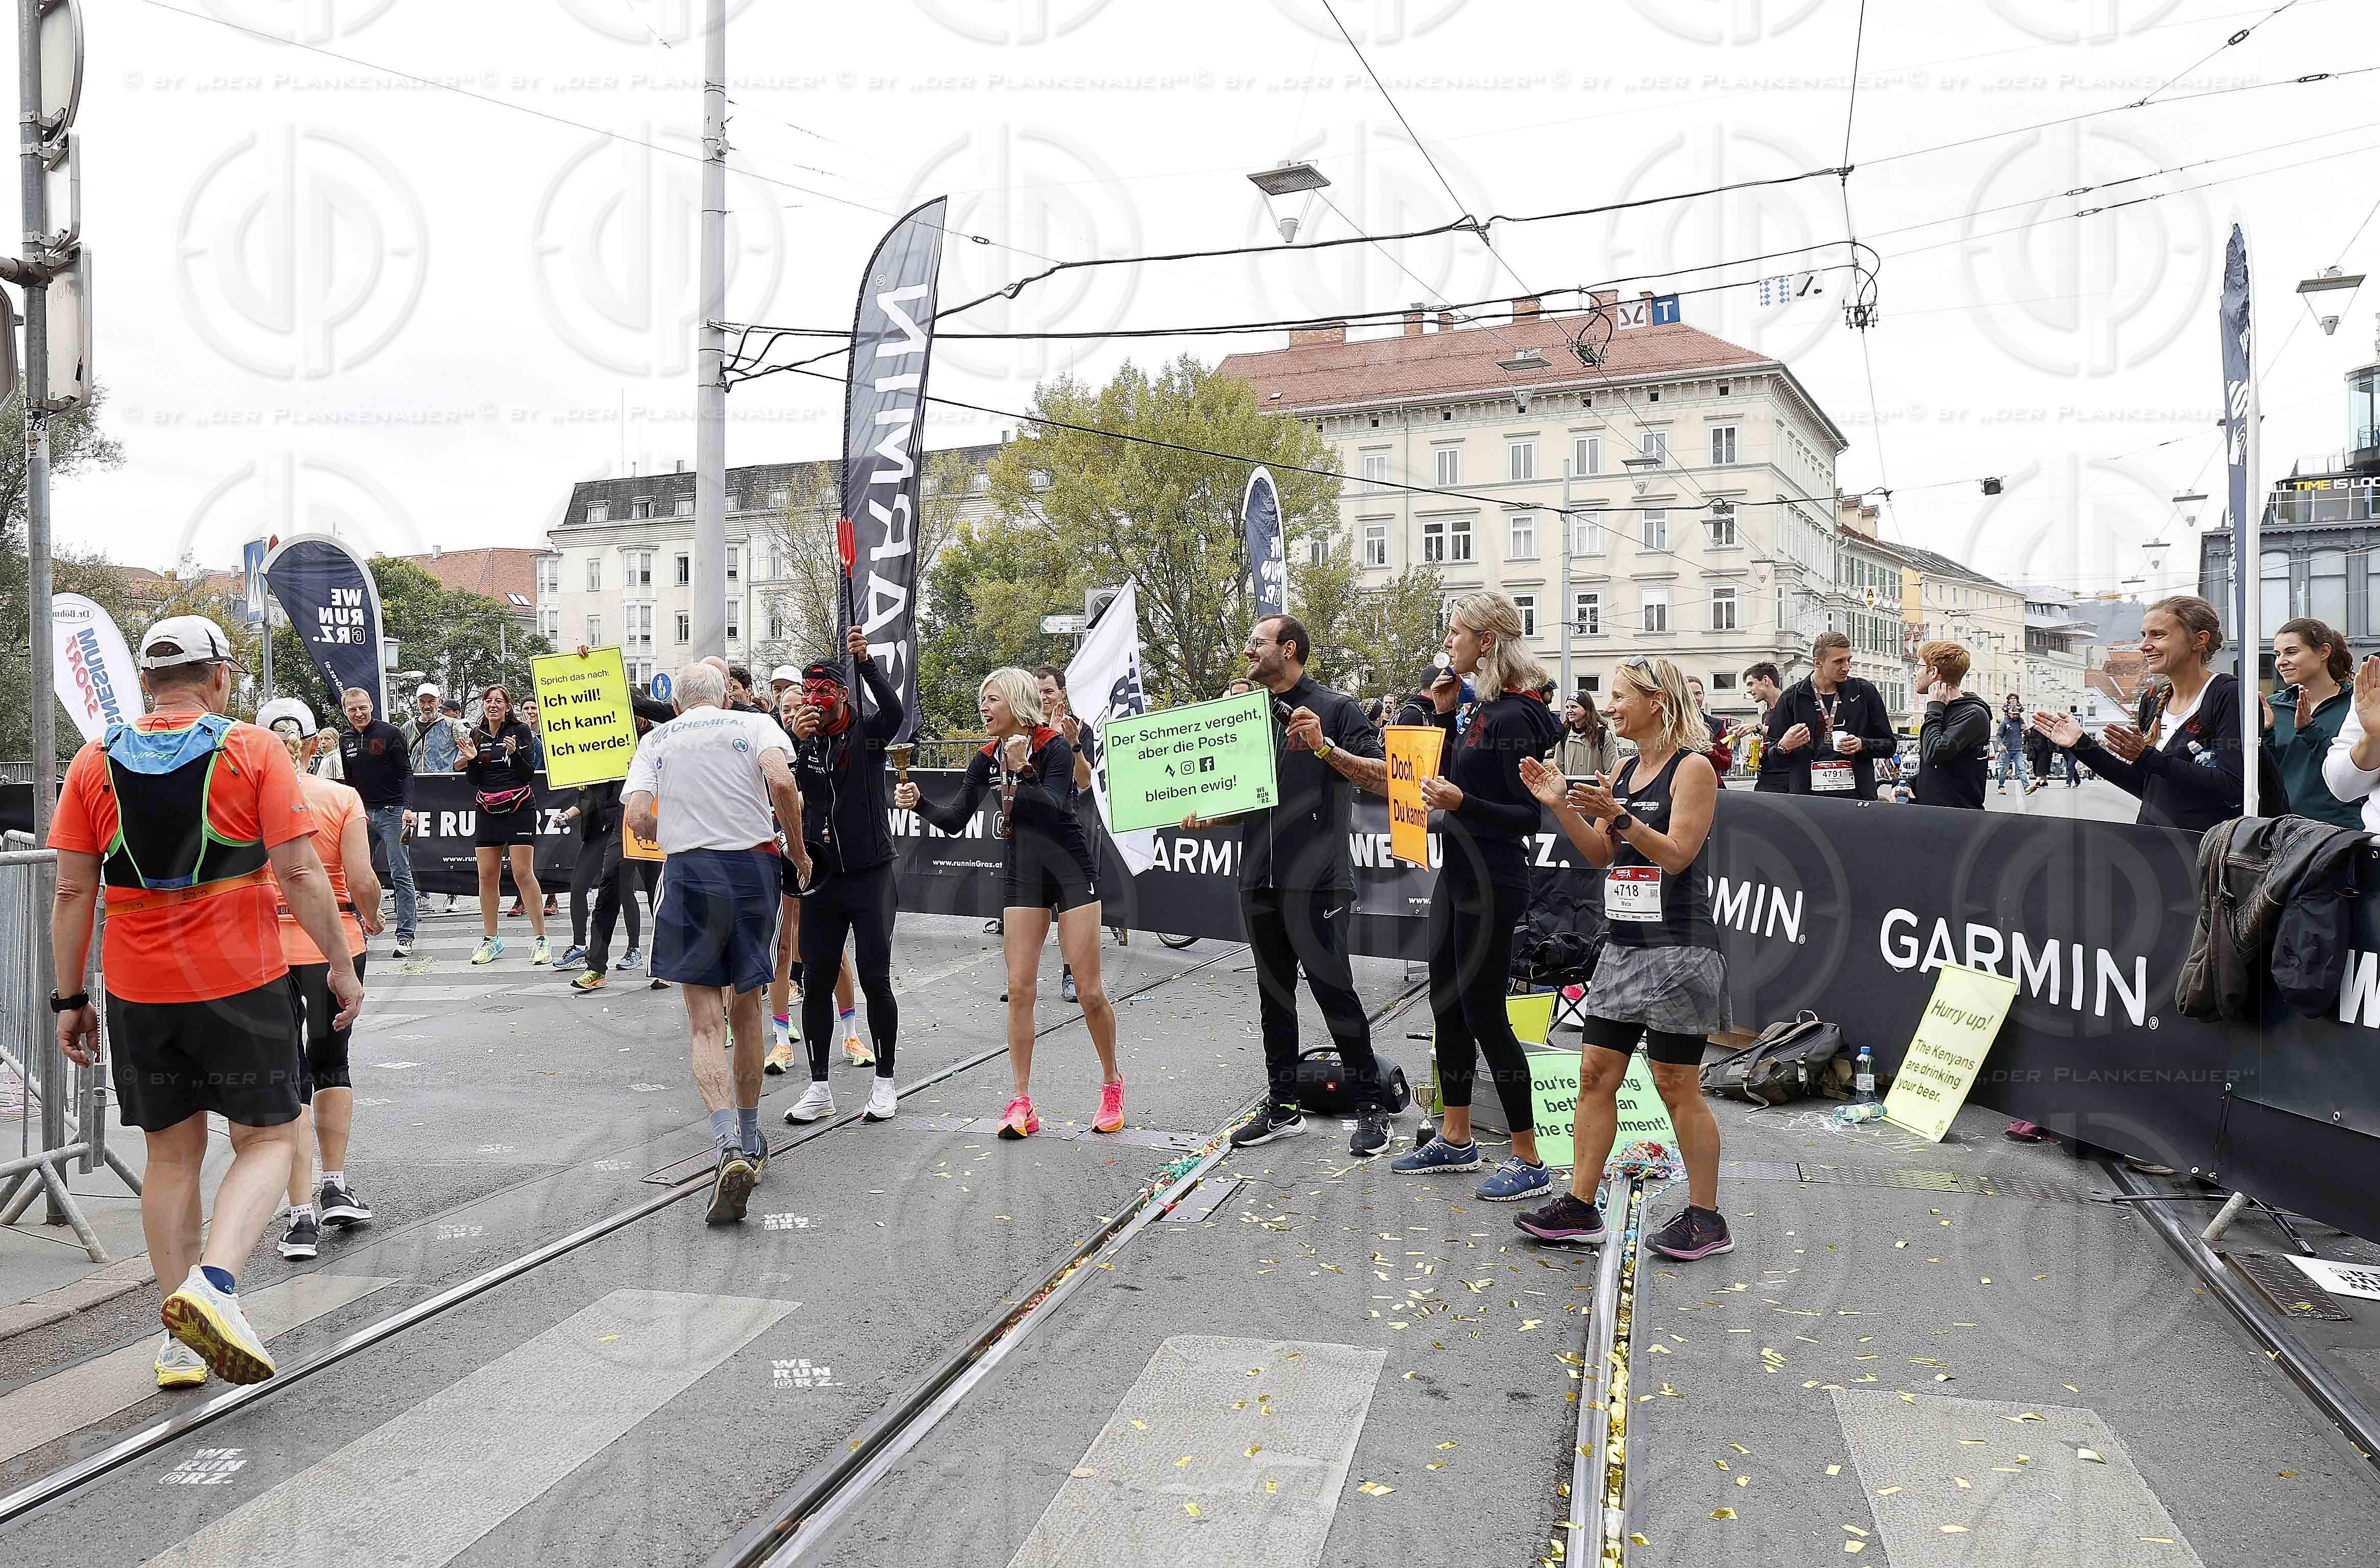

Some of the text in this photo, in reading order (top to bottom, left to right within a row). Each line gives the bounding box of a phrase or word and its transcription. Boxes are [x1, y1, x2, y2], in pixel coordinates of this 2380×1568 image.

[2293, 480, 2331, 491] TIME
[2334, 479, 2348, 489] IS
[540, 671, 609, 687] Sprich das nach:
[544, 689, 601, 708] Ich will!
[548, 712, 616, 732] Ich kann!
[1111, 733, 1136, 747] Der
[1139, 721, 1201, 744] Schmerz
[1205, 707, 1262, 735] vergeht,
[551, 734, 631, 757] Ich werde!
[1137, 732, 1238, 761] aber die Posts
[1391, 753, 1415, 786] Doch,
[1822, 770, 1843, 778] 4791
[1145, 775, 1237, 802] bleiben ewig!
[1393, 799, 1405, 823] Du
[439, 811, 476, 837] RU
[933, 860, 1003, 869] www.runninGraz.at
[1614, 883, 1639, 897] 4718
[1930, 1000, 1994, 1032] Hurry up!
[1915, 1039, 1975, 1071] The Kenyans
[1906, 1059, 1962, 1089] are drinking
[1896, 1078, 1942, 1102] your beer.
[192, 1448, 245, 1460] WE
[174, 1460, 248, 1472] RUN
